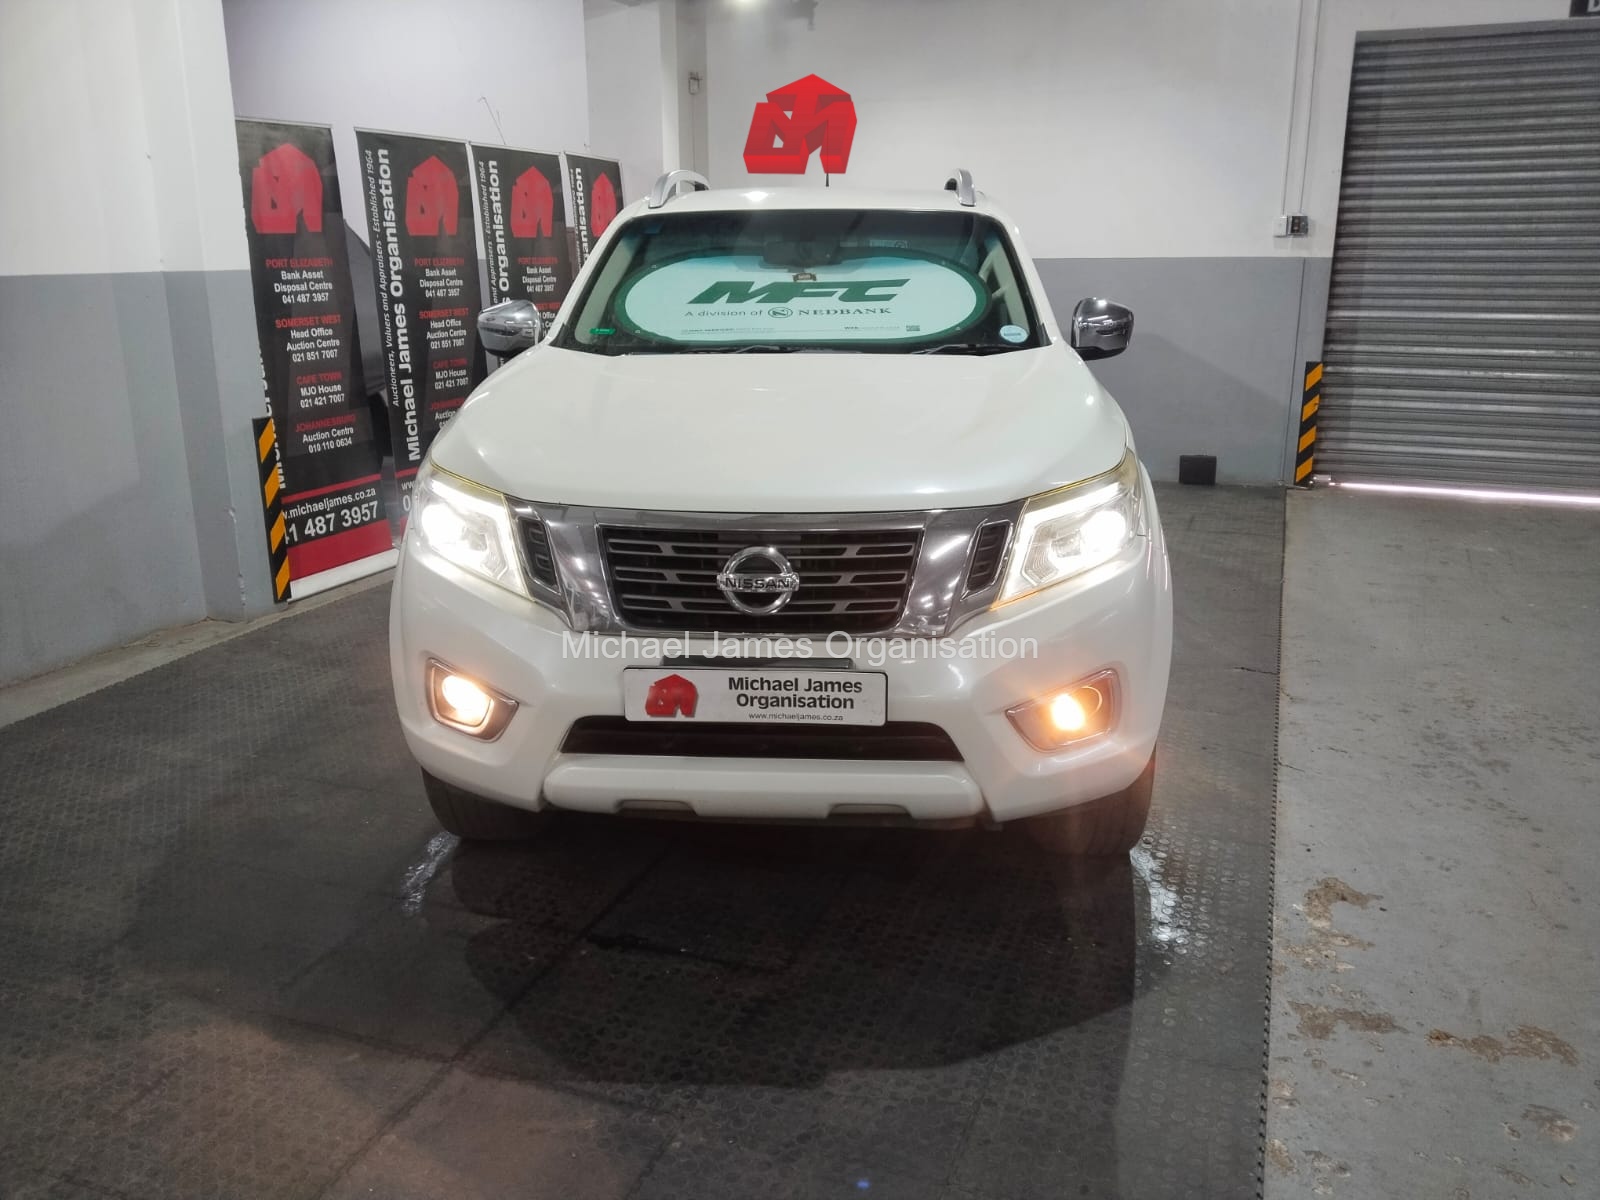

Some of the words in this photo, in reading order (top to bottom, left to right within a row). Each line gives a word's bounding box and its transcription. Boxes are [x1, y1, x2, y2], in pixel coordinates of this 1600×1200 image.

[364, 149, 374, 175] 1964
[367, 175, 381, 232] Established
[265, 258, 288, 268] PORT
[376, 240, 388, 291] Appraisers
[281, 270, 301, 280] Bank
[302, 270, 324, 279] Asset
[425, 268, 440, 277] Bank
[441, 268, 457, 276] Asset
[274, 282, 307, 294] Disposal
[308, 281, 333, 290] Centre
[419, 279, 445, 288] Disposal
[445, 278, 464, 287] Centre
[282, 294, 295, 304] 041
[296, 293, 310, 303] 487
[312, 292, 329, 302] 3957
[687, 279, 911, 304] MFC
[380, 291, 389, 311] and
[750, 309, 763, 317] of
[799, 307, 892, 316] NEDBANK
[275, 317, 320, 328] SOMERSET
[320, 314, 341, 325] WEST
[430, 320, 445, 329] Head
[445, 319, 462, 327] Office
[290, 329, 309, 339] Head
[310, 327, 333, 337] Office
[384, 313, 393, 348] Valuers
[426, 331, 449, 340] Auction
[449, 329, 467, 337] Centre
[286, 341, 315, 352] Auction
[316, 338, 340, 348] Centre
[394, 303, 412, 374] James
[430, 340, 441, 349] 021
[292, 353, 305, 362] 021
[306, 351, 320, 361] 851
[321, 349, 338, 359] 7007
[296, 374, 317, 385] CAPE
[318, 372, 342, 382] TOWN
[388, 350, 400, 407] Auctioneers,
[435, 371, 448, 380] MJO
[448, 369, 467, 378] House
[300, 386, 316, 397] MJO
[318, 384, 342, 394] House
[300, 399, 313, 408] 021
[314, 396, 327, 406] 421
[328, 393, 345, 403] 7007
[400, 378, 421, 461] Michael
[302, 431, 330, 444] Auction
[331, 426, 354, 437] Centre
[308, 444, 322, 454] 010
[322, 440, 335, 450] 110
[335, 437, 353, 448] 0634
[304, 512, 335, 537] 487
[340, 501, 379, 527] 3957
[725, 577, 790, 589] NISSAN
[728, 677, 799, 692] Michael
[803, 678, 863, 693] James
[736, 693, 855, 710] Organisation
[748, 712, 844, 721] www.michaeljames.co.za
